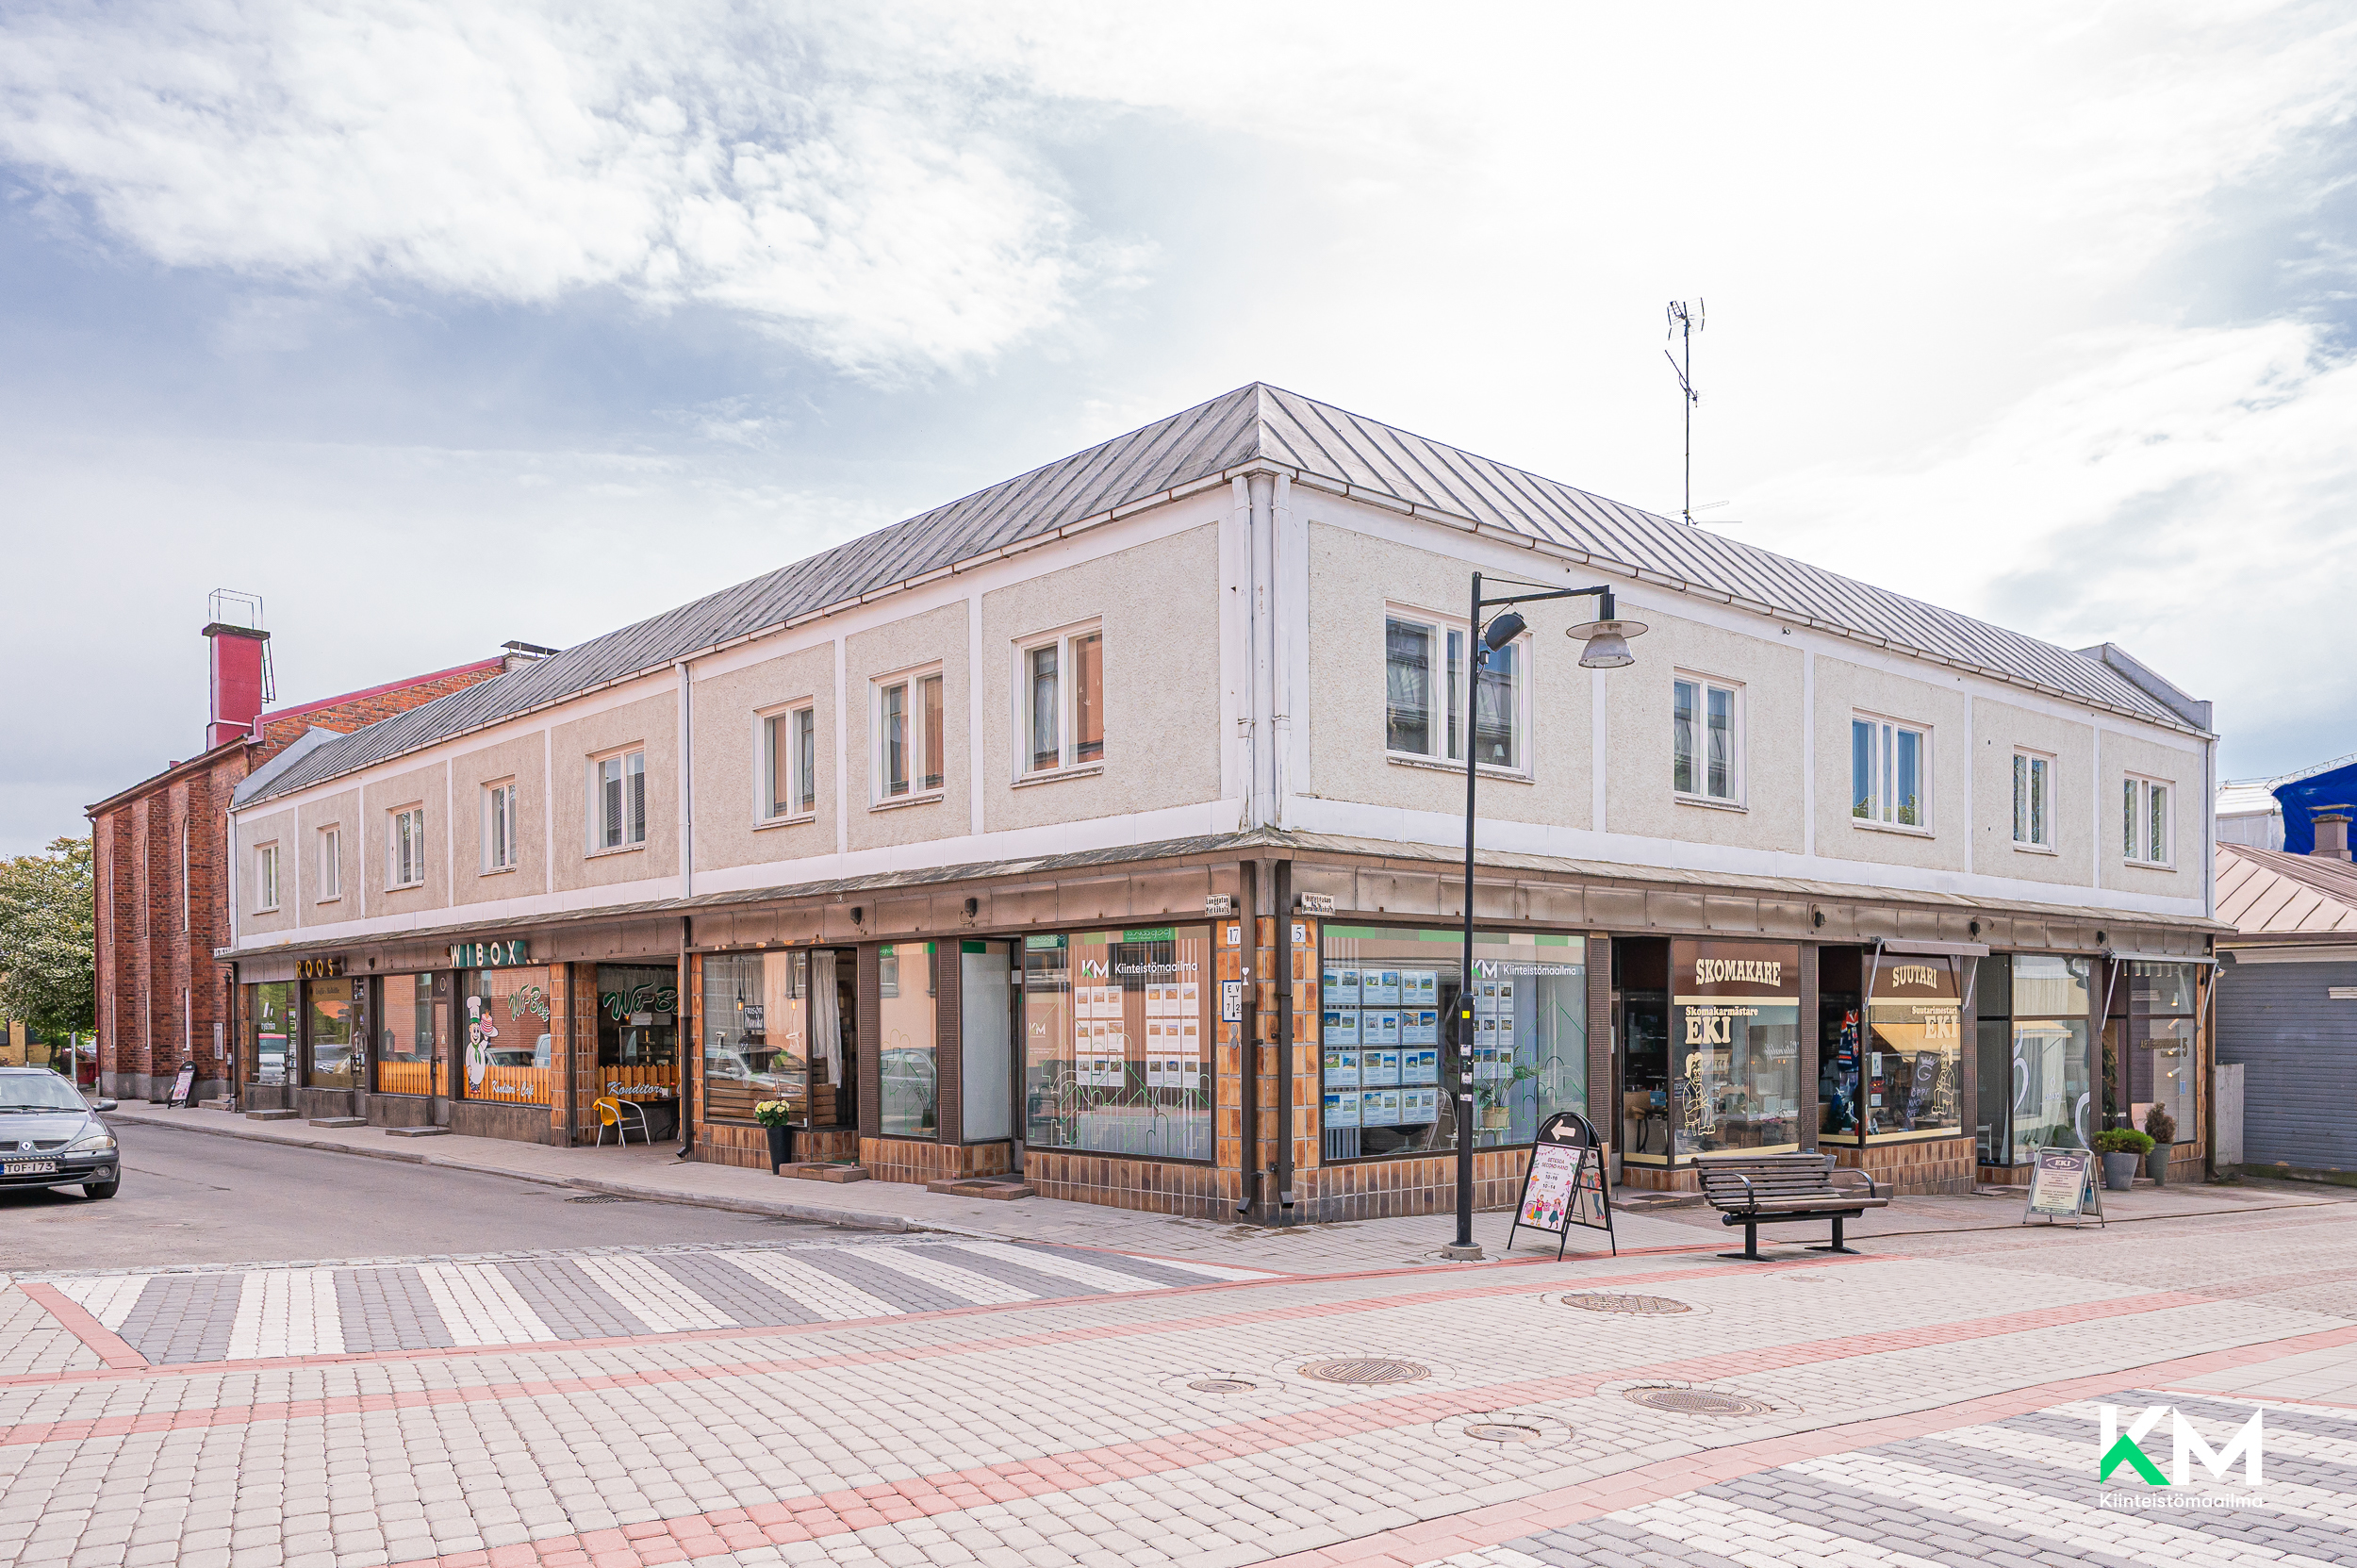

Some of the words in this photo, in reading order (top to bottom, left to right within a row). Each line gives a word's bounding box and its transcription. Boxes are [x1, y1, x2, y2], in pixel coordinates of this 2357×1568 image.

[1229, 929, 1239, 942] 17
[1295, 927, 1302, 941] 5
[451, 940, 517, 967] WIBOX
[296, 959, 334, 978] ROOS
[1082, 960, 1109, 978] KM
[1115, 961, 1197, 974] Kiinteistömaailma
[1472, 960, 1497, 978] KM
[1503, 965, 1575, 976] Kiinteistömaailma
[1696, 959, 1781, 987] SKOMAKARE
[1892, 966, 1937, 989] SUUTARI
[603, 981, 678, 1020] Wi-B
[1911, 1005, 1957, 1015] Suutarimestari
[1685, 1006, 1759, 1016] Skomakarmästare
[1685, 1016, 1731, 1044] EKI
[1924, 1015, 1957, 1038] EKI
[2183, 1037, 2188, 1057] 5
[7, 1163, 53, 1172] TOF-173
